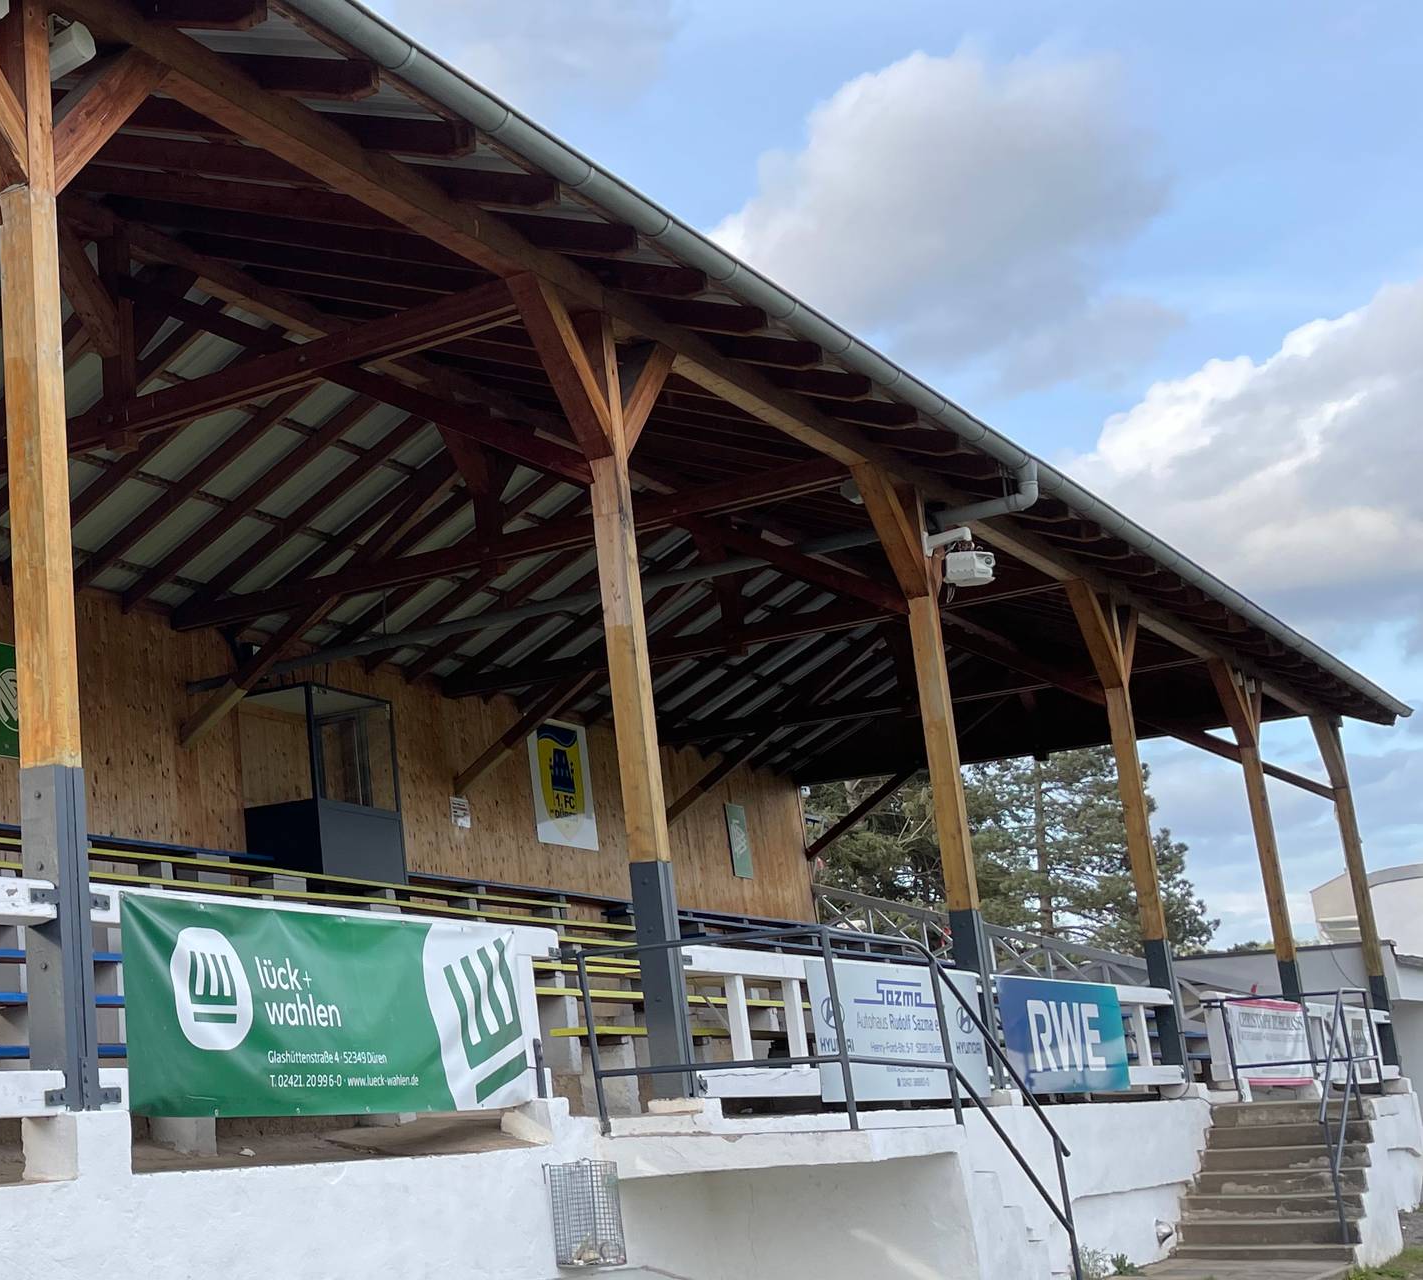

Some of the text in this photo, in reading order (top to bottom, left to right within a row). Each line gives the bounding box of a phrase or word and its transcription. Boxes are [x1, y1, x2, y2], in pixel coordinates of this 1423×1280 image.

[563, 795, 575, 809] FC
[854, 979, 937, 1008] Sazma
[265, 993, 342, 1028] wahlen
[856, 1011, 888, 1030] Autohaus
[889, 1013, 911, 1030] Rudolf
[912, 1014, 934, 1031] Sazma
[819, 1037, 855, 1052] HYUAI
[1026, 999, 1108, 1073] RWE
[267, 1050, 333, 1064] Glashüttenstraße
[343, 1051, 366, 1064] 52349
[367, 1051, 388, 1064] Düren
[347, 1074, 419, 1087] www.lueck-wahlen.de
